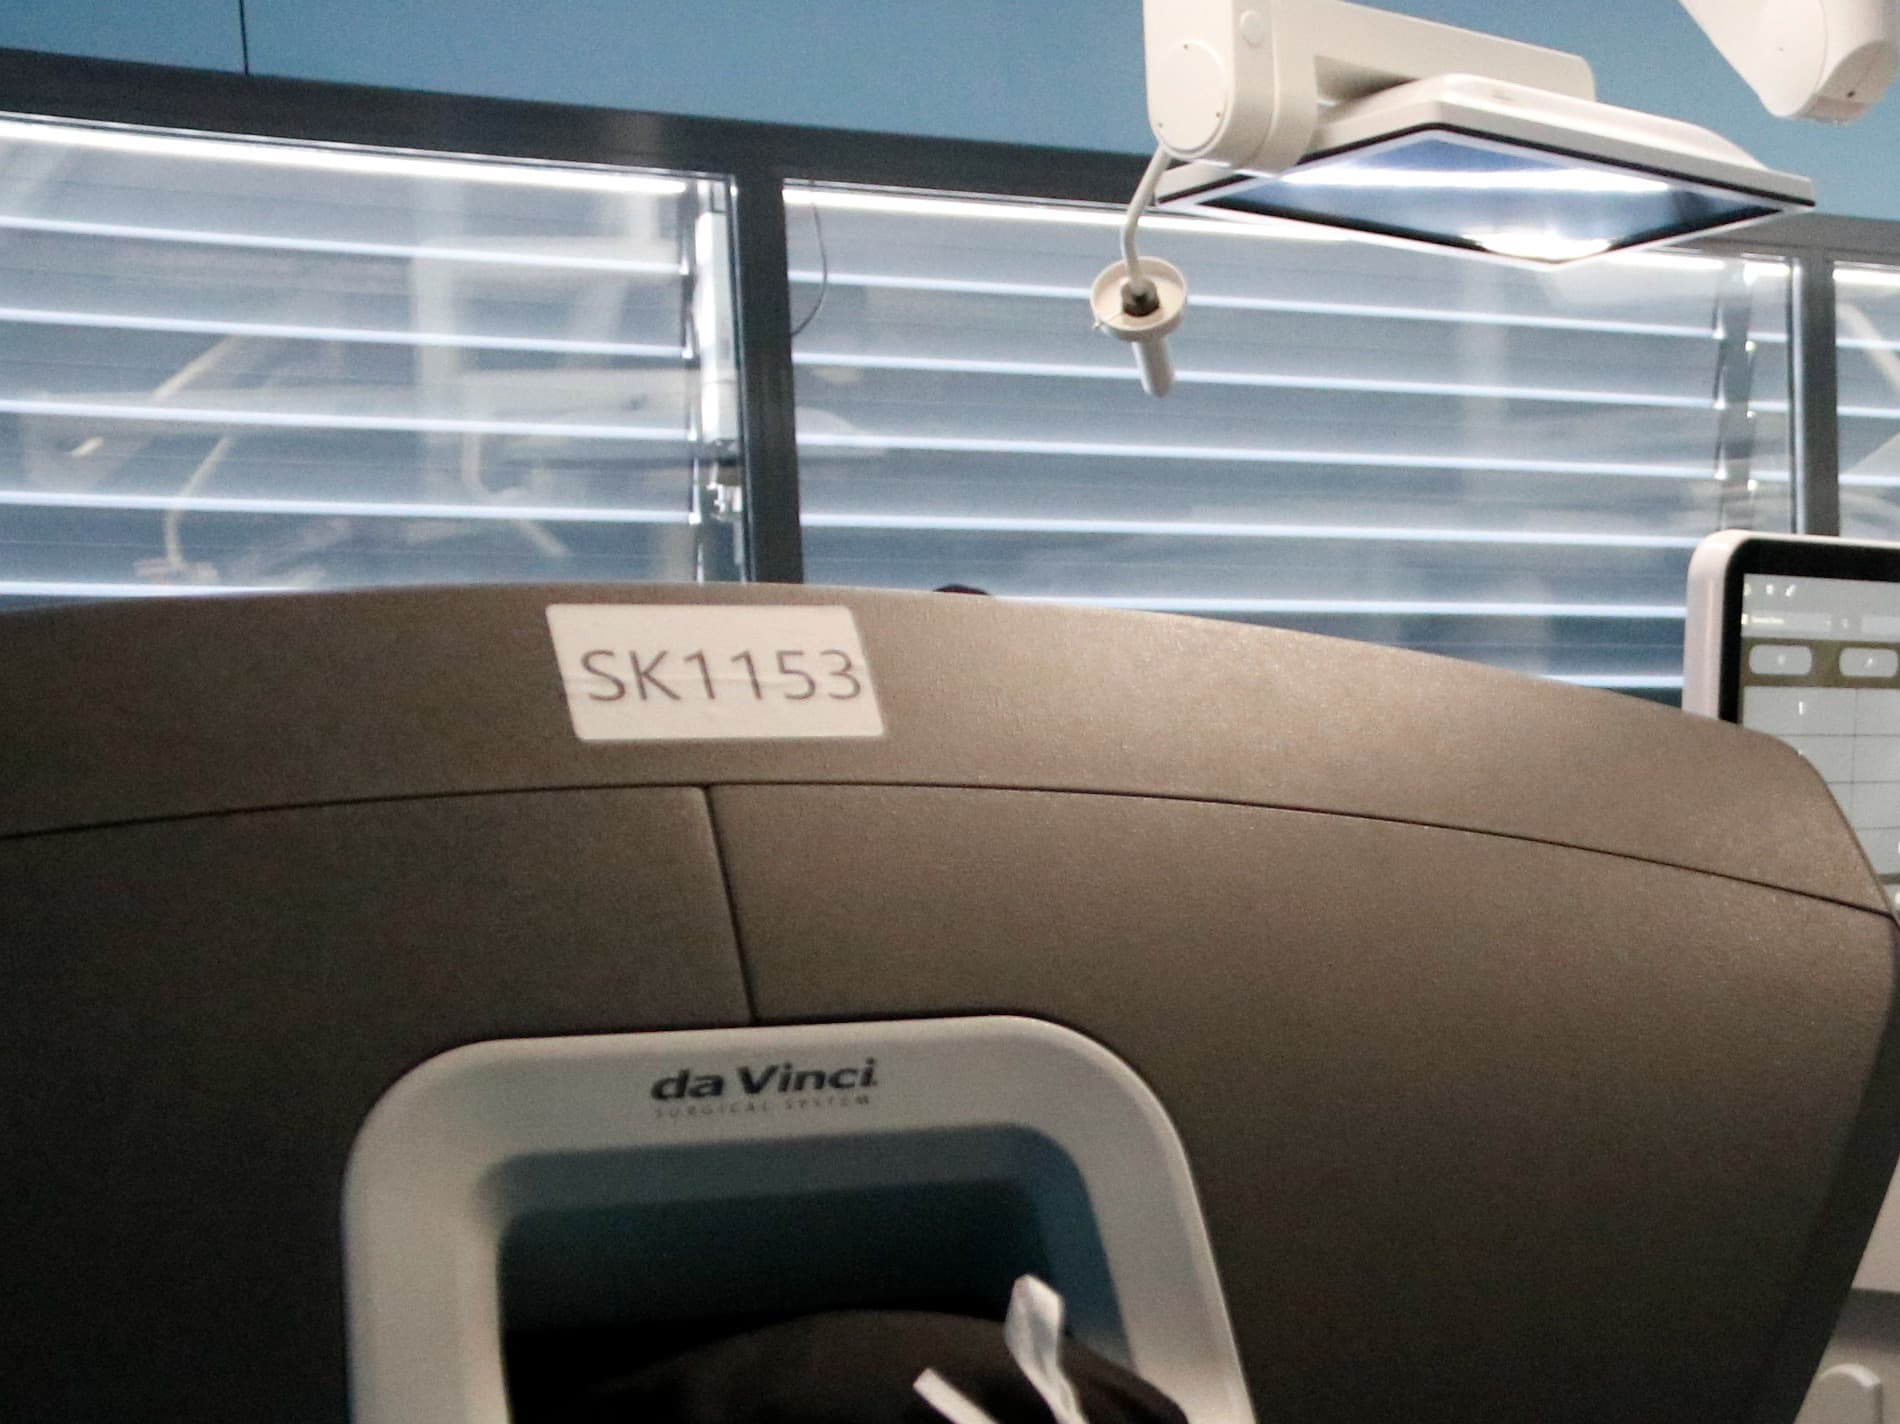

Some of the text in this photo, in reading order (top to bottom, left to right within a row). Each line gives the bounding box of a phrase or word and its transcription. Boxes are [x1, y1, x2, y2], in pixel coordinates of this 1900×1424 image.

[581, 649, 862, 701] SK1153
[650, 1056, 877, 1101] da Vinci
